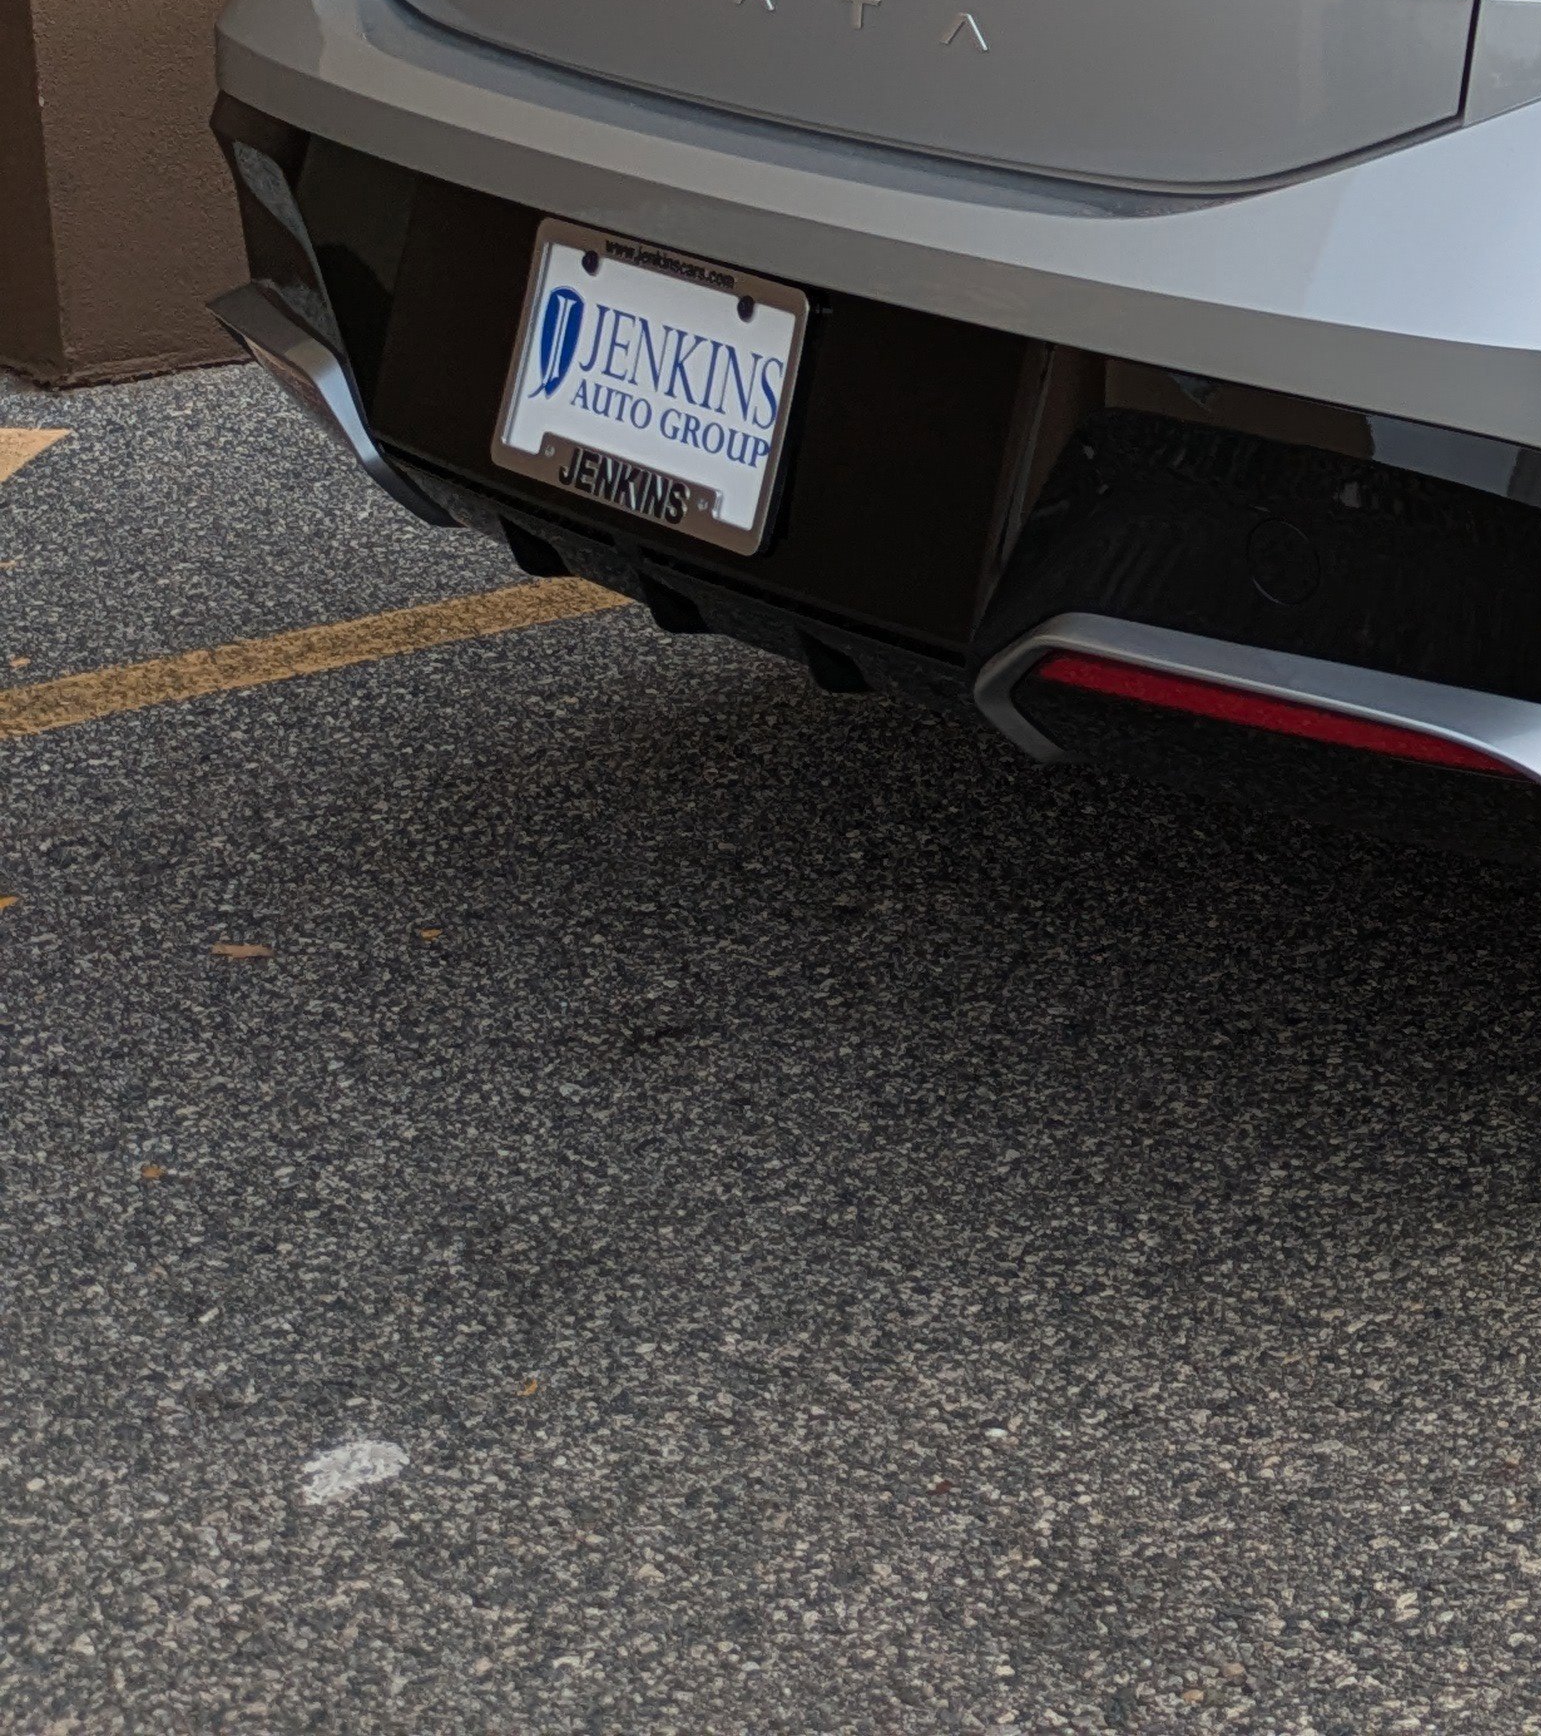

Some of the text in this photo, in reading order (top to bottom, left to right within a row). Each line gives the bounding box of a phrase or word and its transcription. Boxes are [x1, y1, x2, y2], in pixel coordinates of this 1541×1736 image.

[578, 302, 785, 431] JENKINS
[570, 381, 772, 469] AUTO GROUP
[558, 447, 692, 525] JENKINS
